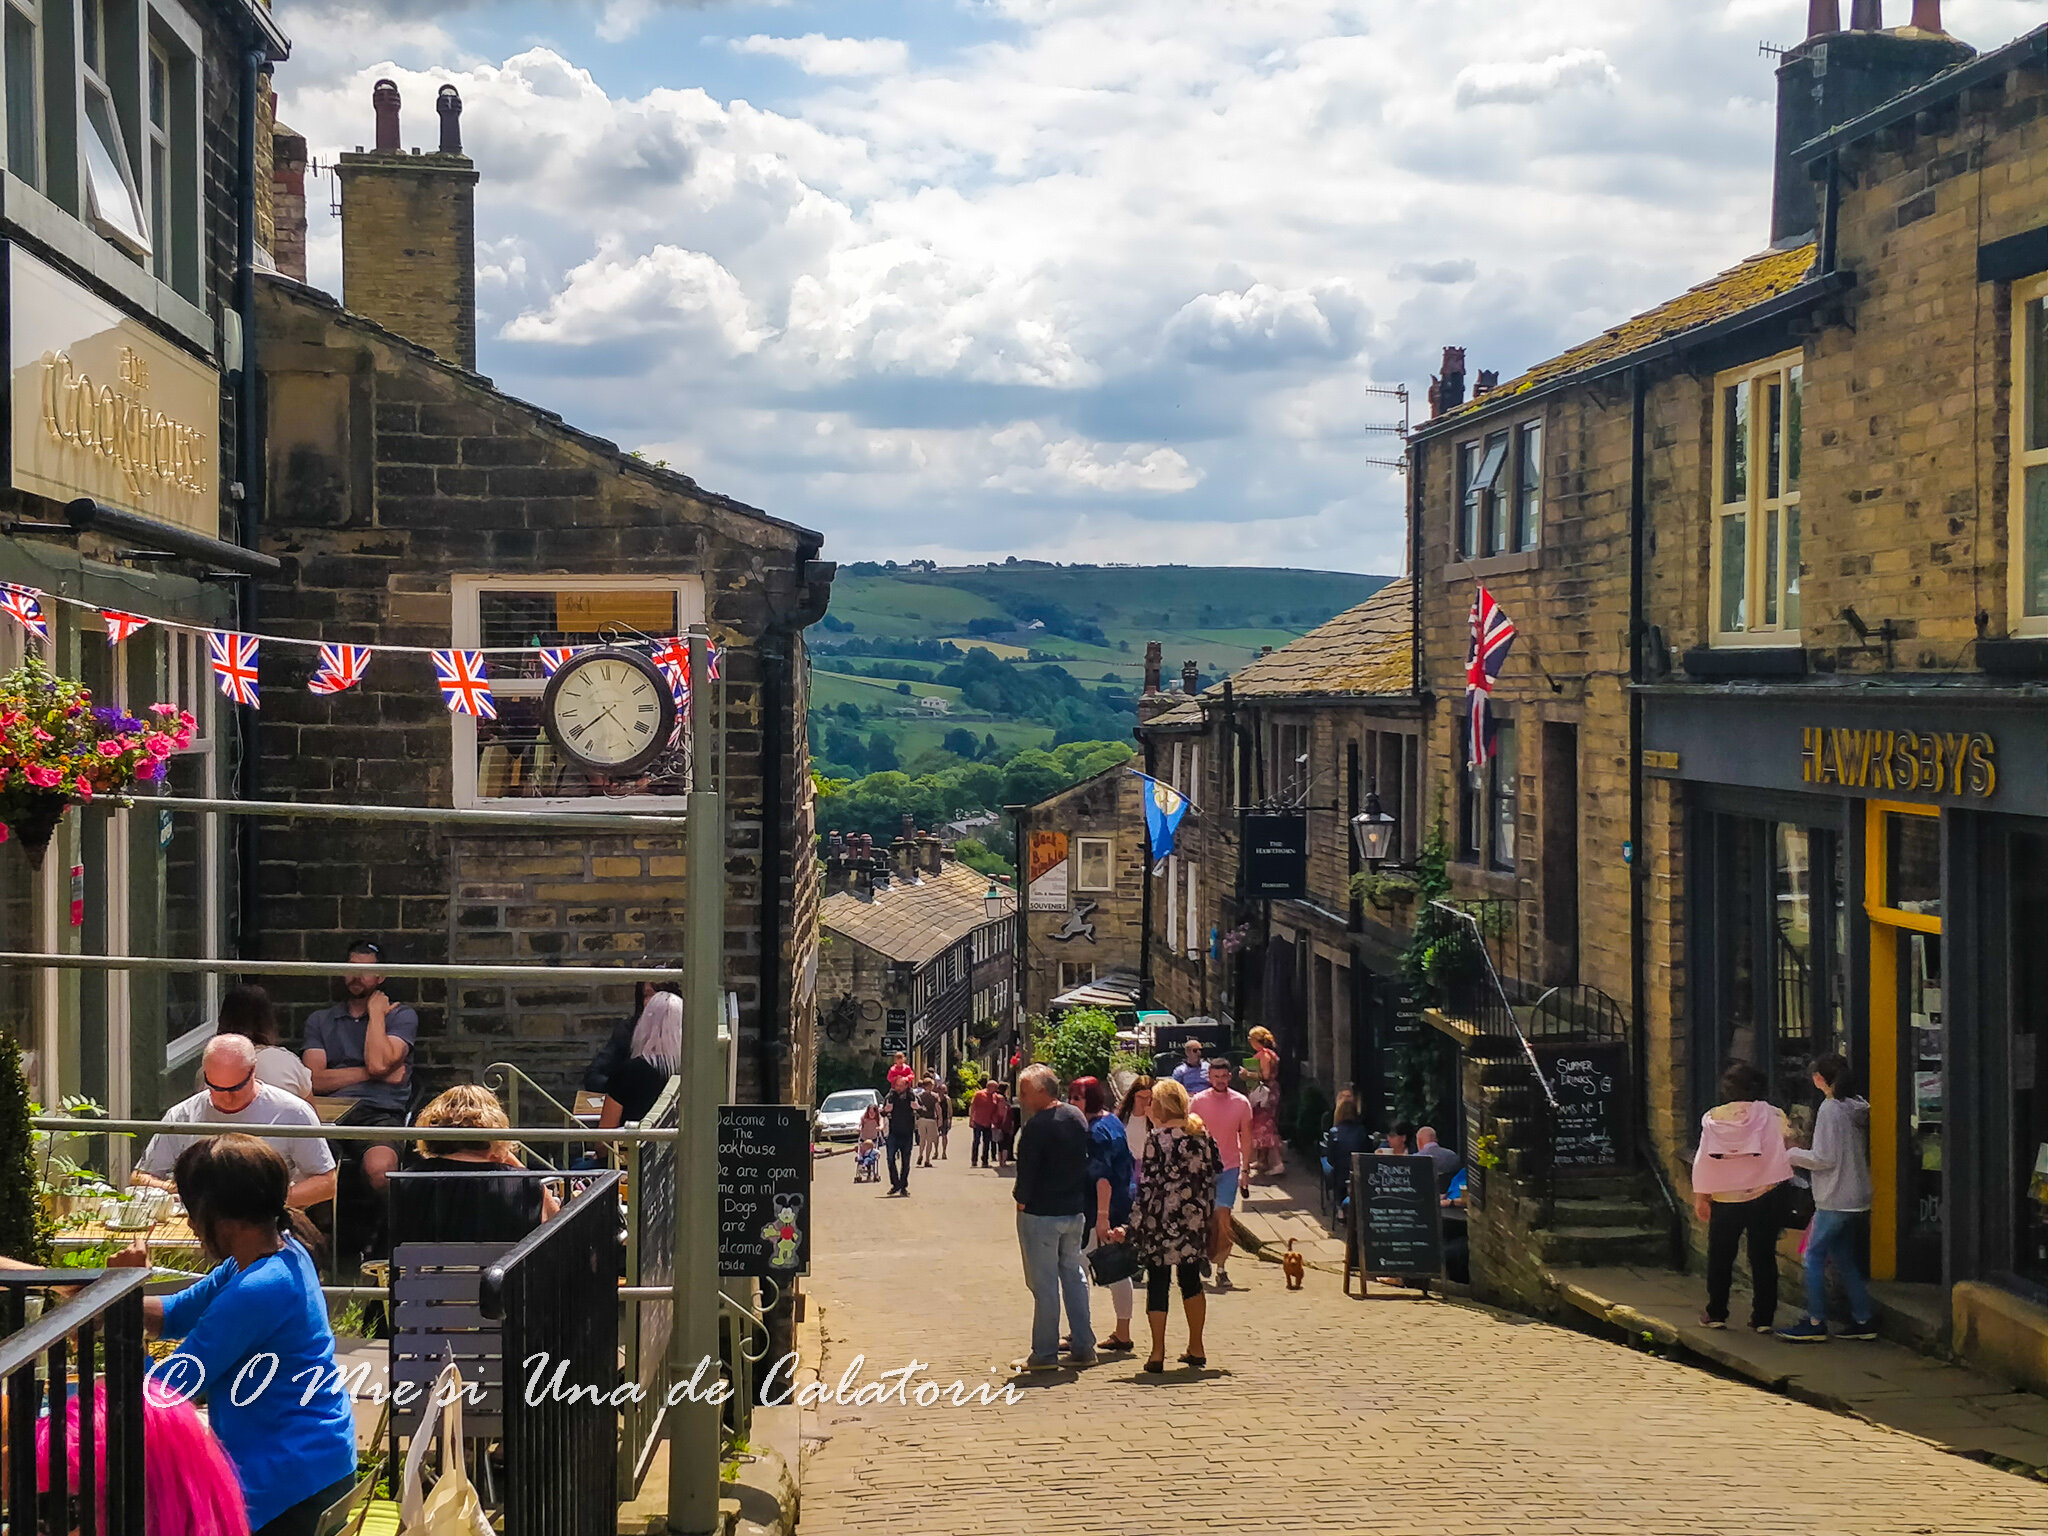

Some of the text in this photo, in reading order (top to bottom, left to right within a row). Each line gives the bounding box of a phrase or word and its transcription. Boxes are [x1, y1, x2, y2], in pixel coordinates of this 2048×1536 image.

[1800, 727, 1996, 798] HAWKSBYS
[1030, 903, 1066, 911] SOUVENIRS
[778, 1113, 789, 1127] to
[733, 1127, 754, 1139] The
[718, 1139, 776, 1159] ookhouse
[736, 1166, 758, 1177] are
[740, 1183, 755, 1195] on
[724, 1198, 757, 1220] Dogs
[721, 1221, 746, 1232] are
[718, 1237, 762, 1255] elcome
[717, 1260, 745, 1271] nside
